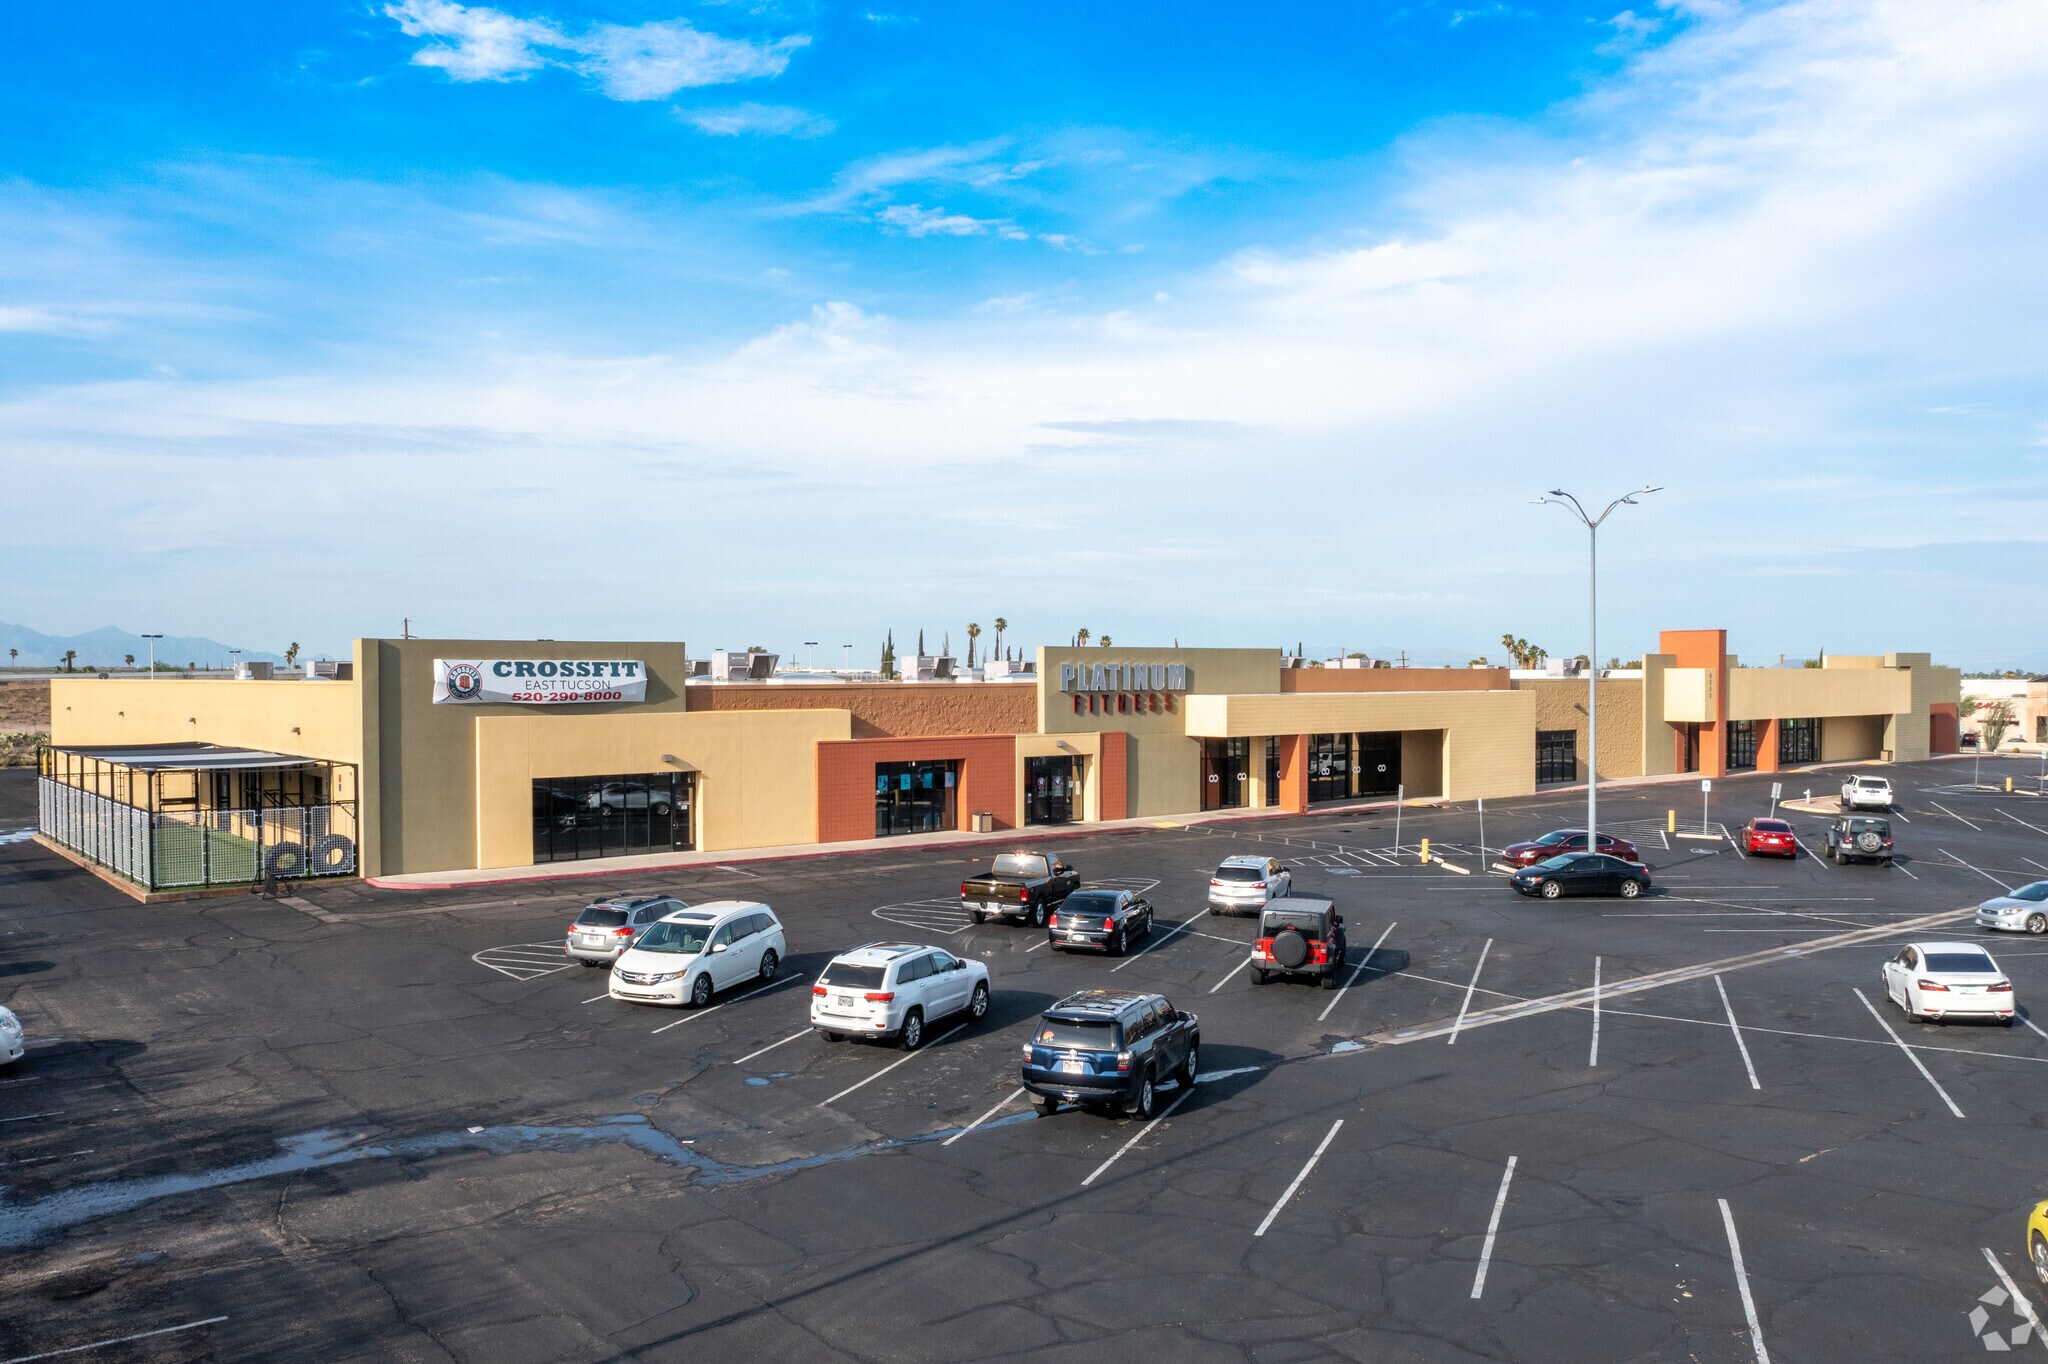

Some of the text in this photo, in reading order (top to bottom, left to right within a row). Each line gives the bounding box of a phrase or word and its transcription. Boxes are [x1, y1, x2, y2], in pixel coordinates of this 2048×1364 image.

[450, 666, 479, 681] CROSSFIT
[493, 661, 638, 677] CROSSFIT
[1060, 663, 1186, 691] PLATINUM
[525, 680, 610, 690] EAST TUCSON
[511, 692, 622, 701] 520-290-8000
[1072, 694, 1173, 713] FITNESS
